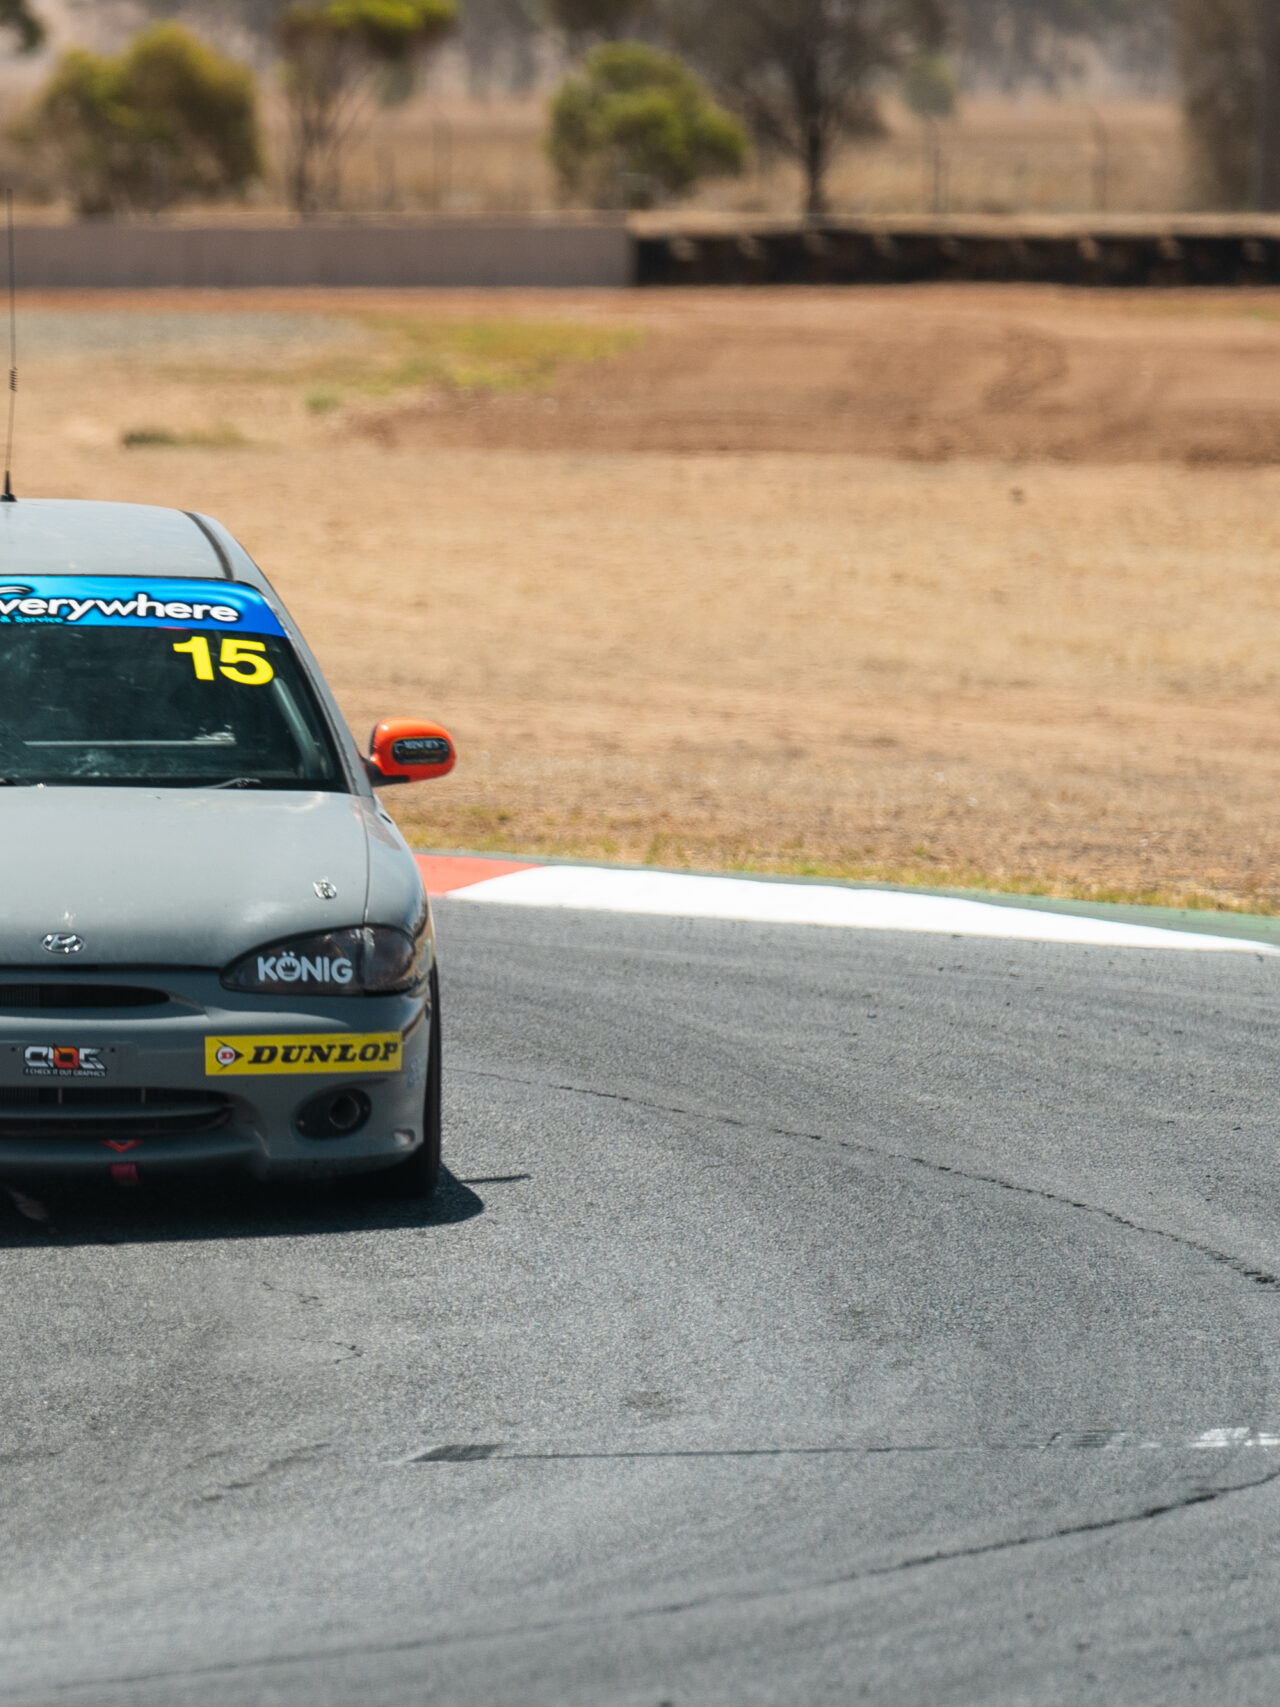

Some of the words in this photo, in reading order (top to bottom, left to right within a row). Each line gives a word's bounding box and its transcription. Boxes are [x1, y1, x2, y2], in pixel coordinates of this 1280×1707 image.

[0, 615, 11, 623] &
[15, 615, 63, 624] Service
[173, 636, 274, 685] 15
[257, 951, 353, 984] KÖNIG
[248, 1041, 399, 1064] DUNLOP
[73, 1069, 105, 1077] GRAPHICS
